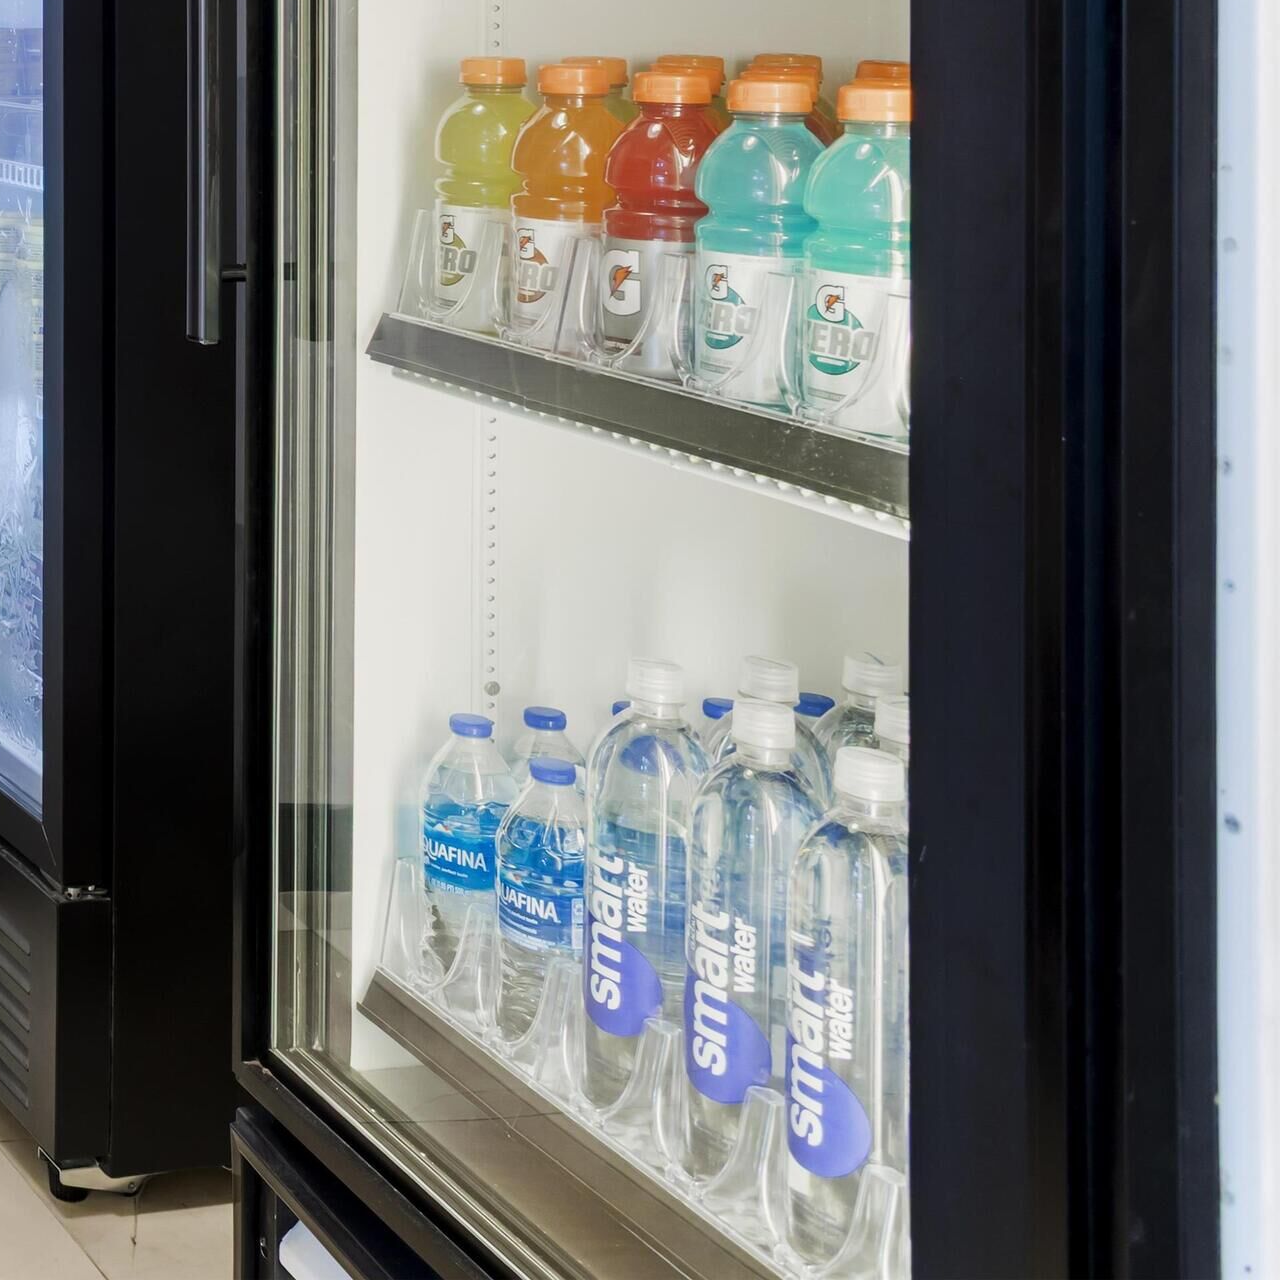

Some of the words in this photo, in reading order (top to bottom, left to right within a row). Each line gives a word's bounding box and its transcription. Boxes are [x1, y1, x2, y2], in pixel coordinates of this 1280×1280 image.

[590, 851, 625, 1010] smart
[624, 862, 649, 933] water
[691, 901, 730, 1077] smart
[730, 917, 758, 994] water
[789, 960, 825, 1147] smart
[826, 978, 854, 1060] water
